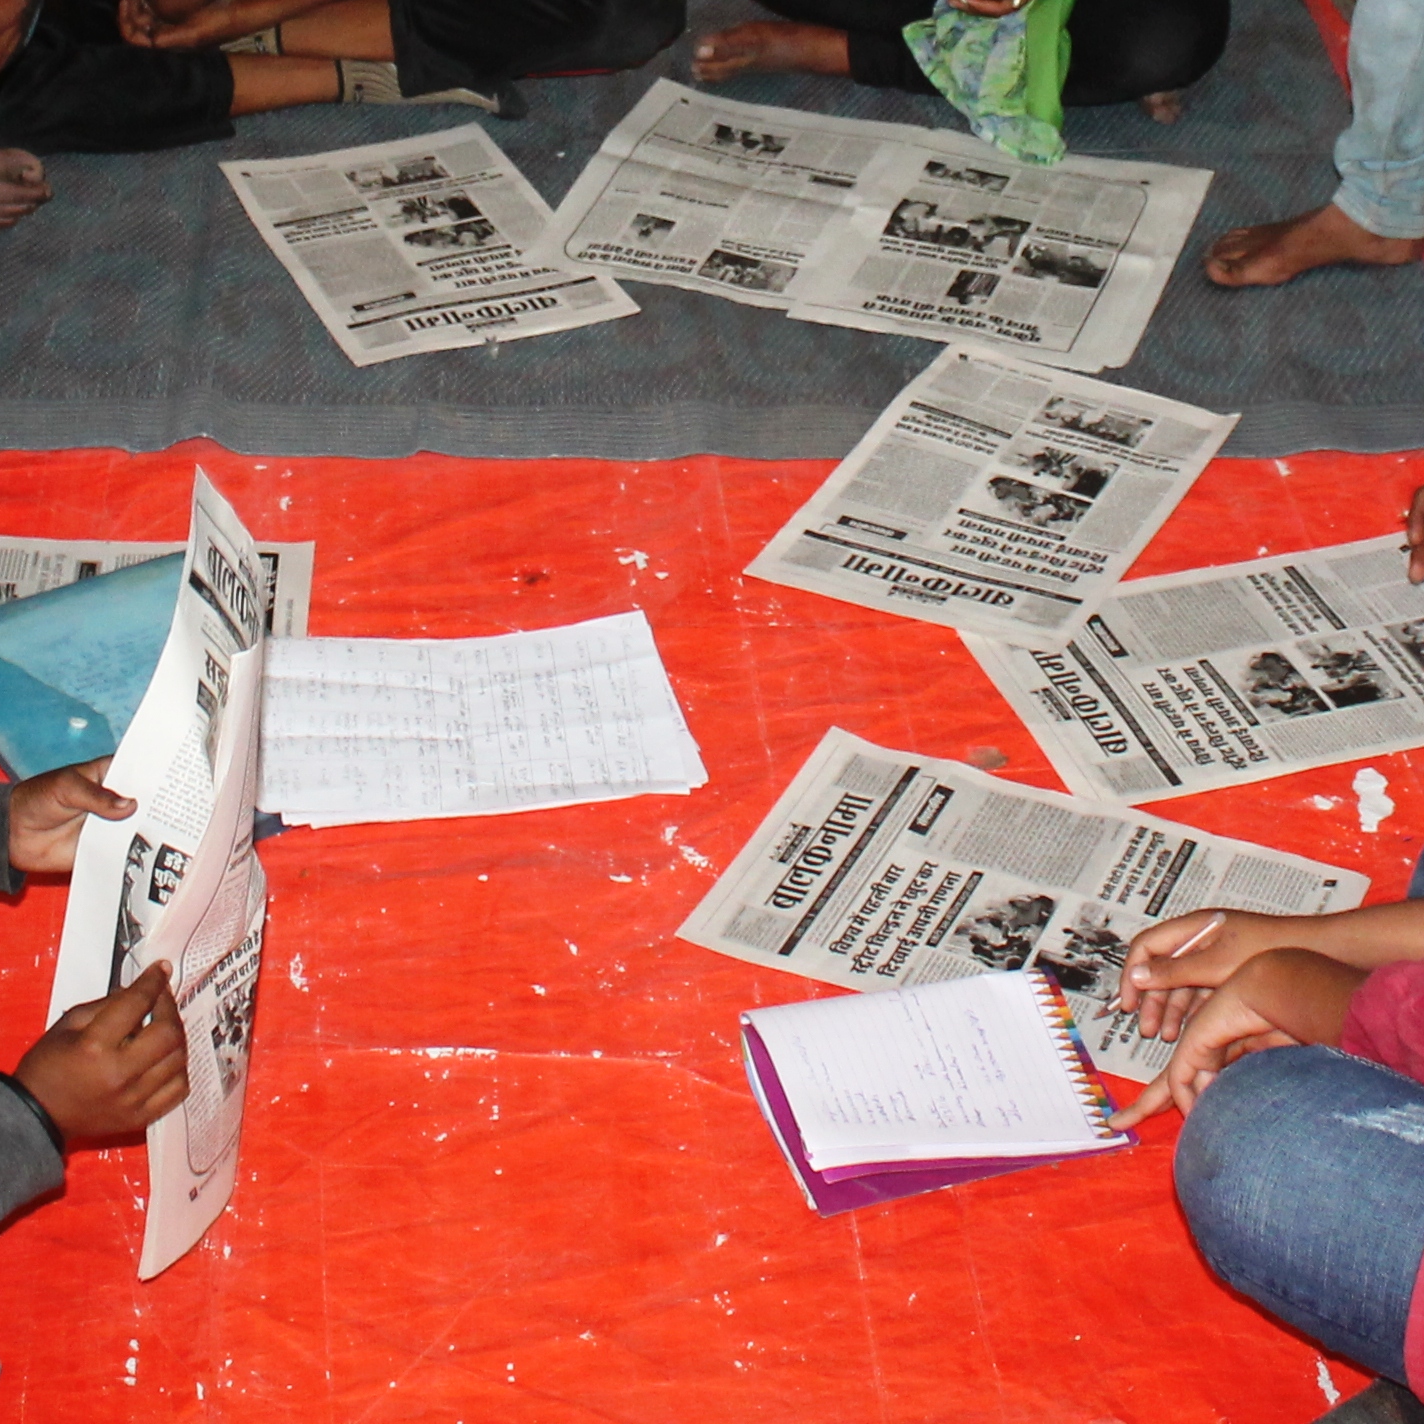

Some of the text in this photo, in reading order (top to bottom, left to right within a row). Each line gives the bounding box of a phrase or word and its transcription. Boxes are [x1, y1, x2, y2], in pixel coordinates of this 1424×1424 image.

[841, 554, 1024, 606] बालकनामा
[1156, 668, 1177, 684] कर
[1168, 684, 1195, 702] खुद
[1182, 702, 1200, 713] ने
[1182, 667, 1269, 762] दिखाई अपनी गणना
[1142, 682, 1216, 765] विश्व में पहली बार
[1218, 747, 1248, 770] स्ट्रीट
[764, 792, 874, 909] बालकनामा
[828, 863, 905, 955] विश्व में पहली बार
[850, 860, 939, 974] स्ट्रीट चिल्ड्रन ने खुद कर
[876, 936, 919, 978] दिखाई
[906, 904, 939, 939] अपनी
[928, 871, 962, 905] गणना
